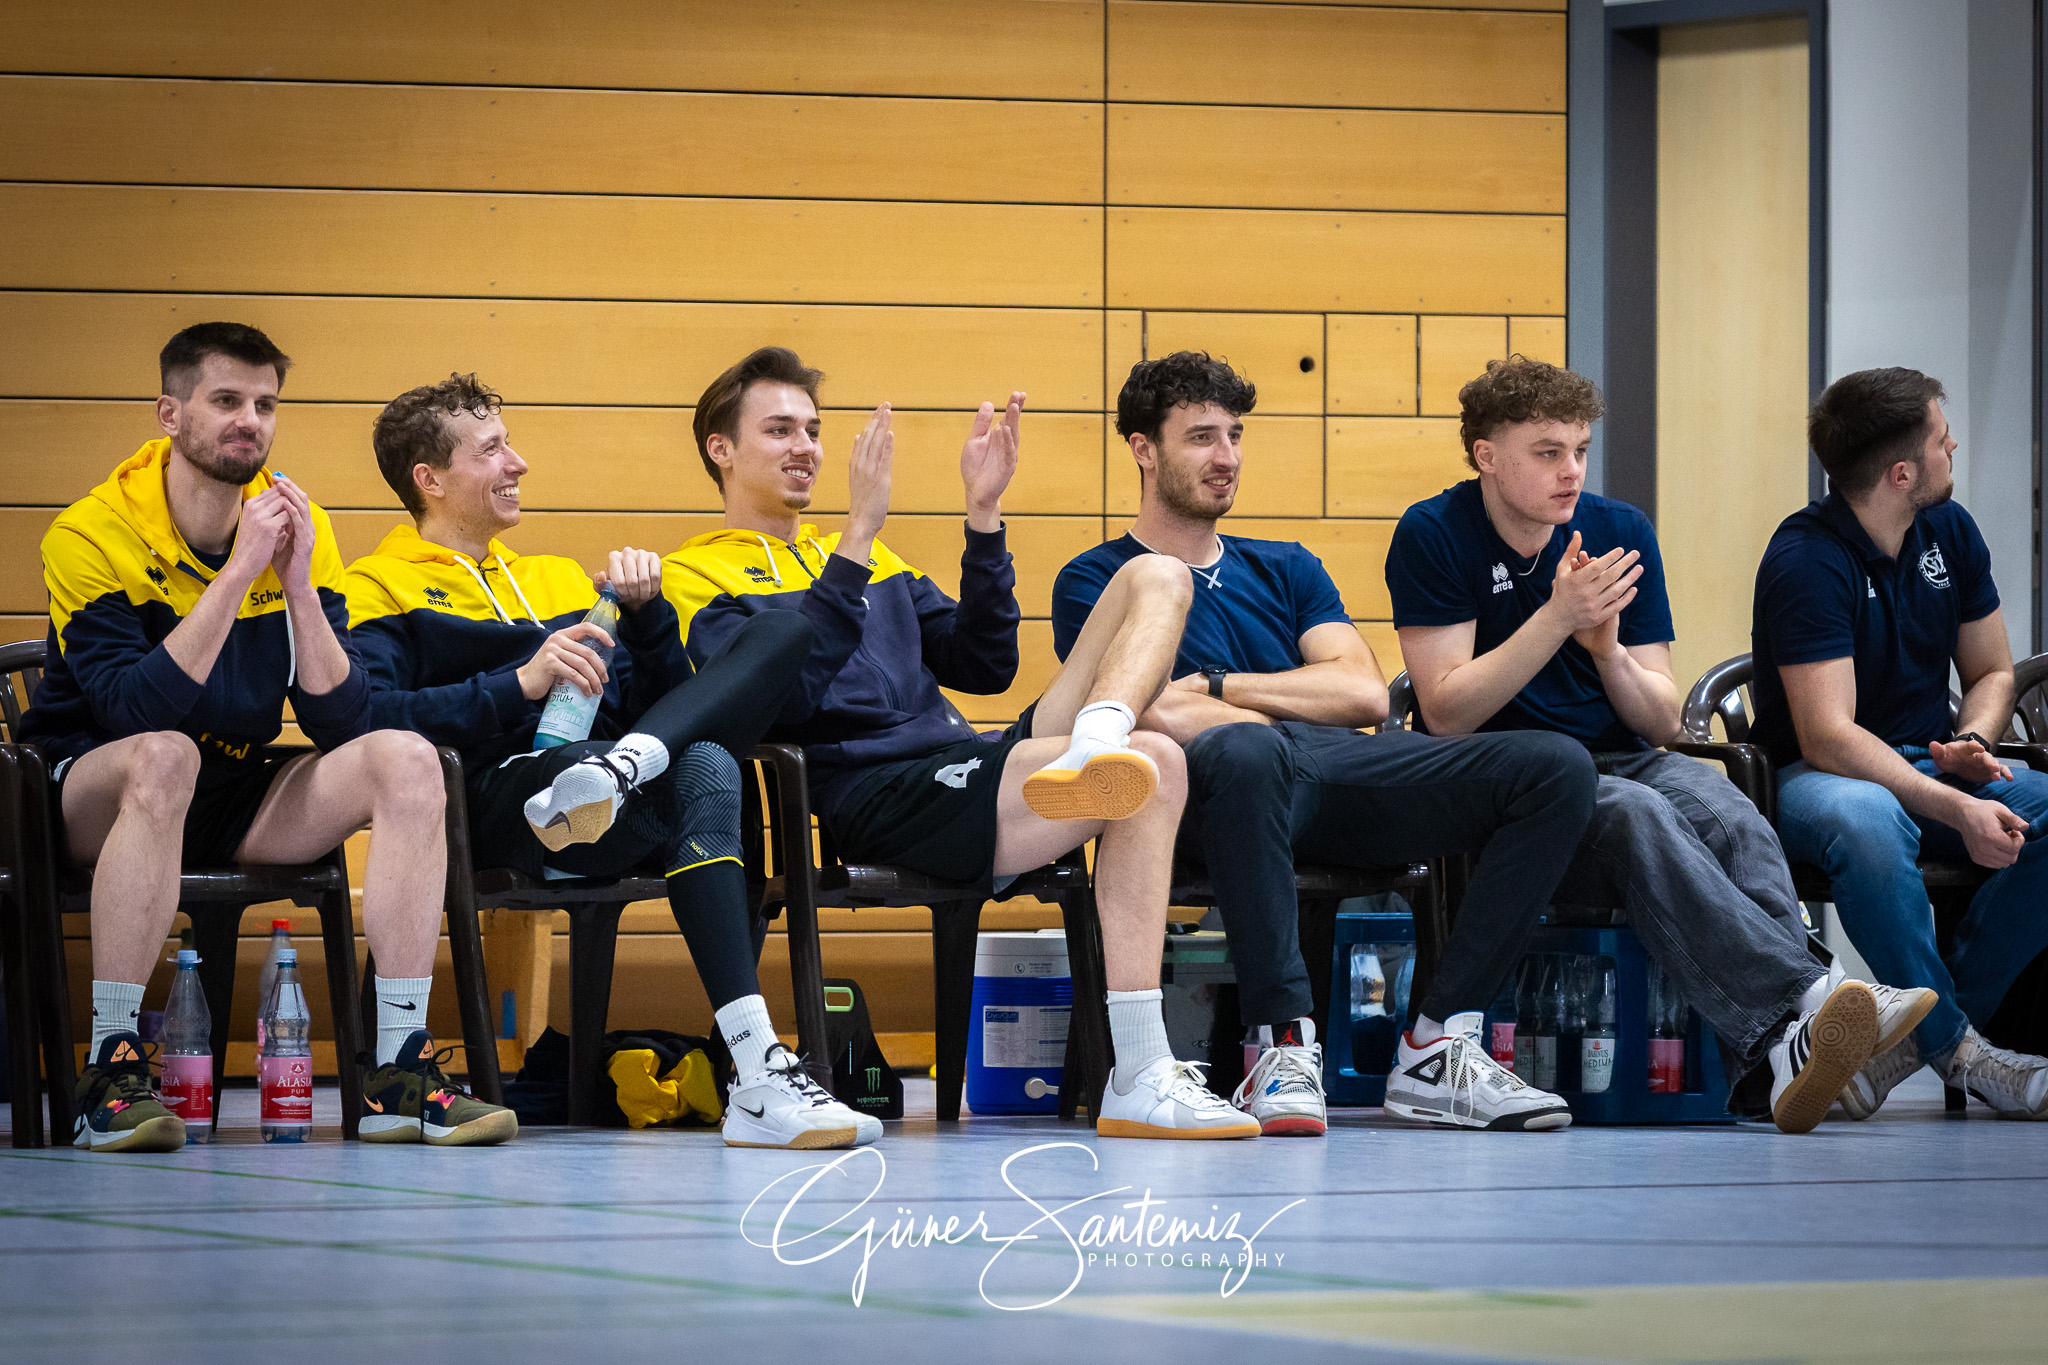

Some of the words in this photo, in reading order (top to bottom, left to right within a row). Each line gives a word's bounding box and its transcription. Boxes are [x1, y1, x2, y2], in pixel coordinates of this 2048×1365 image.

[549, 694, 574, 704] DIUM
[934, 756, 983, 789] 4
[856, 1096, 890, 1104] MONSTER
